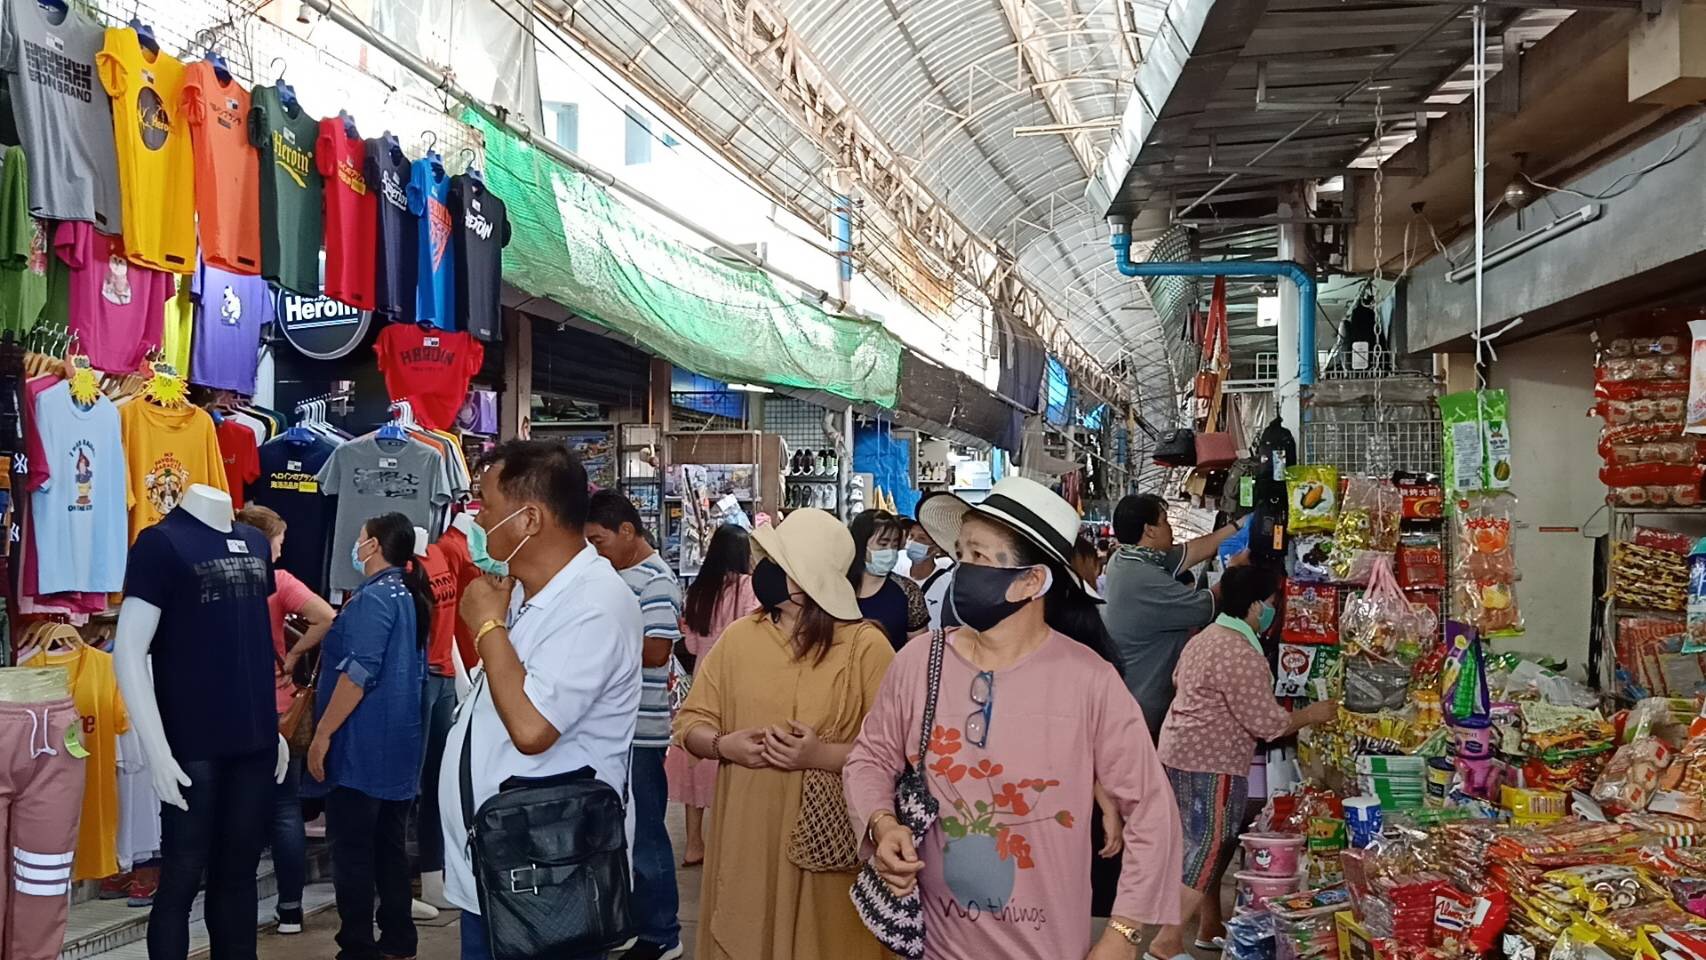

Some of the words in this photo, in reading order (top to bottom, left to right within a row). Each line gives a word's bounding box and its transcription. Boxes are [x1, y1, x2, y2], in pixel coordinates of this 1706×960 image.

[57, 79, 93, 103] BRAND
[272, 130, 309, 173] Heroin
[285, 295, 358, 322] Heroin
[987, 897, 1047, 931] things
